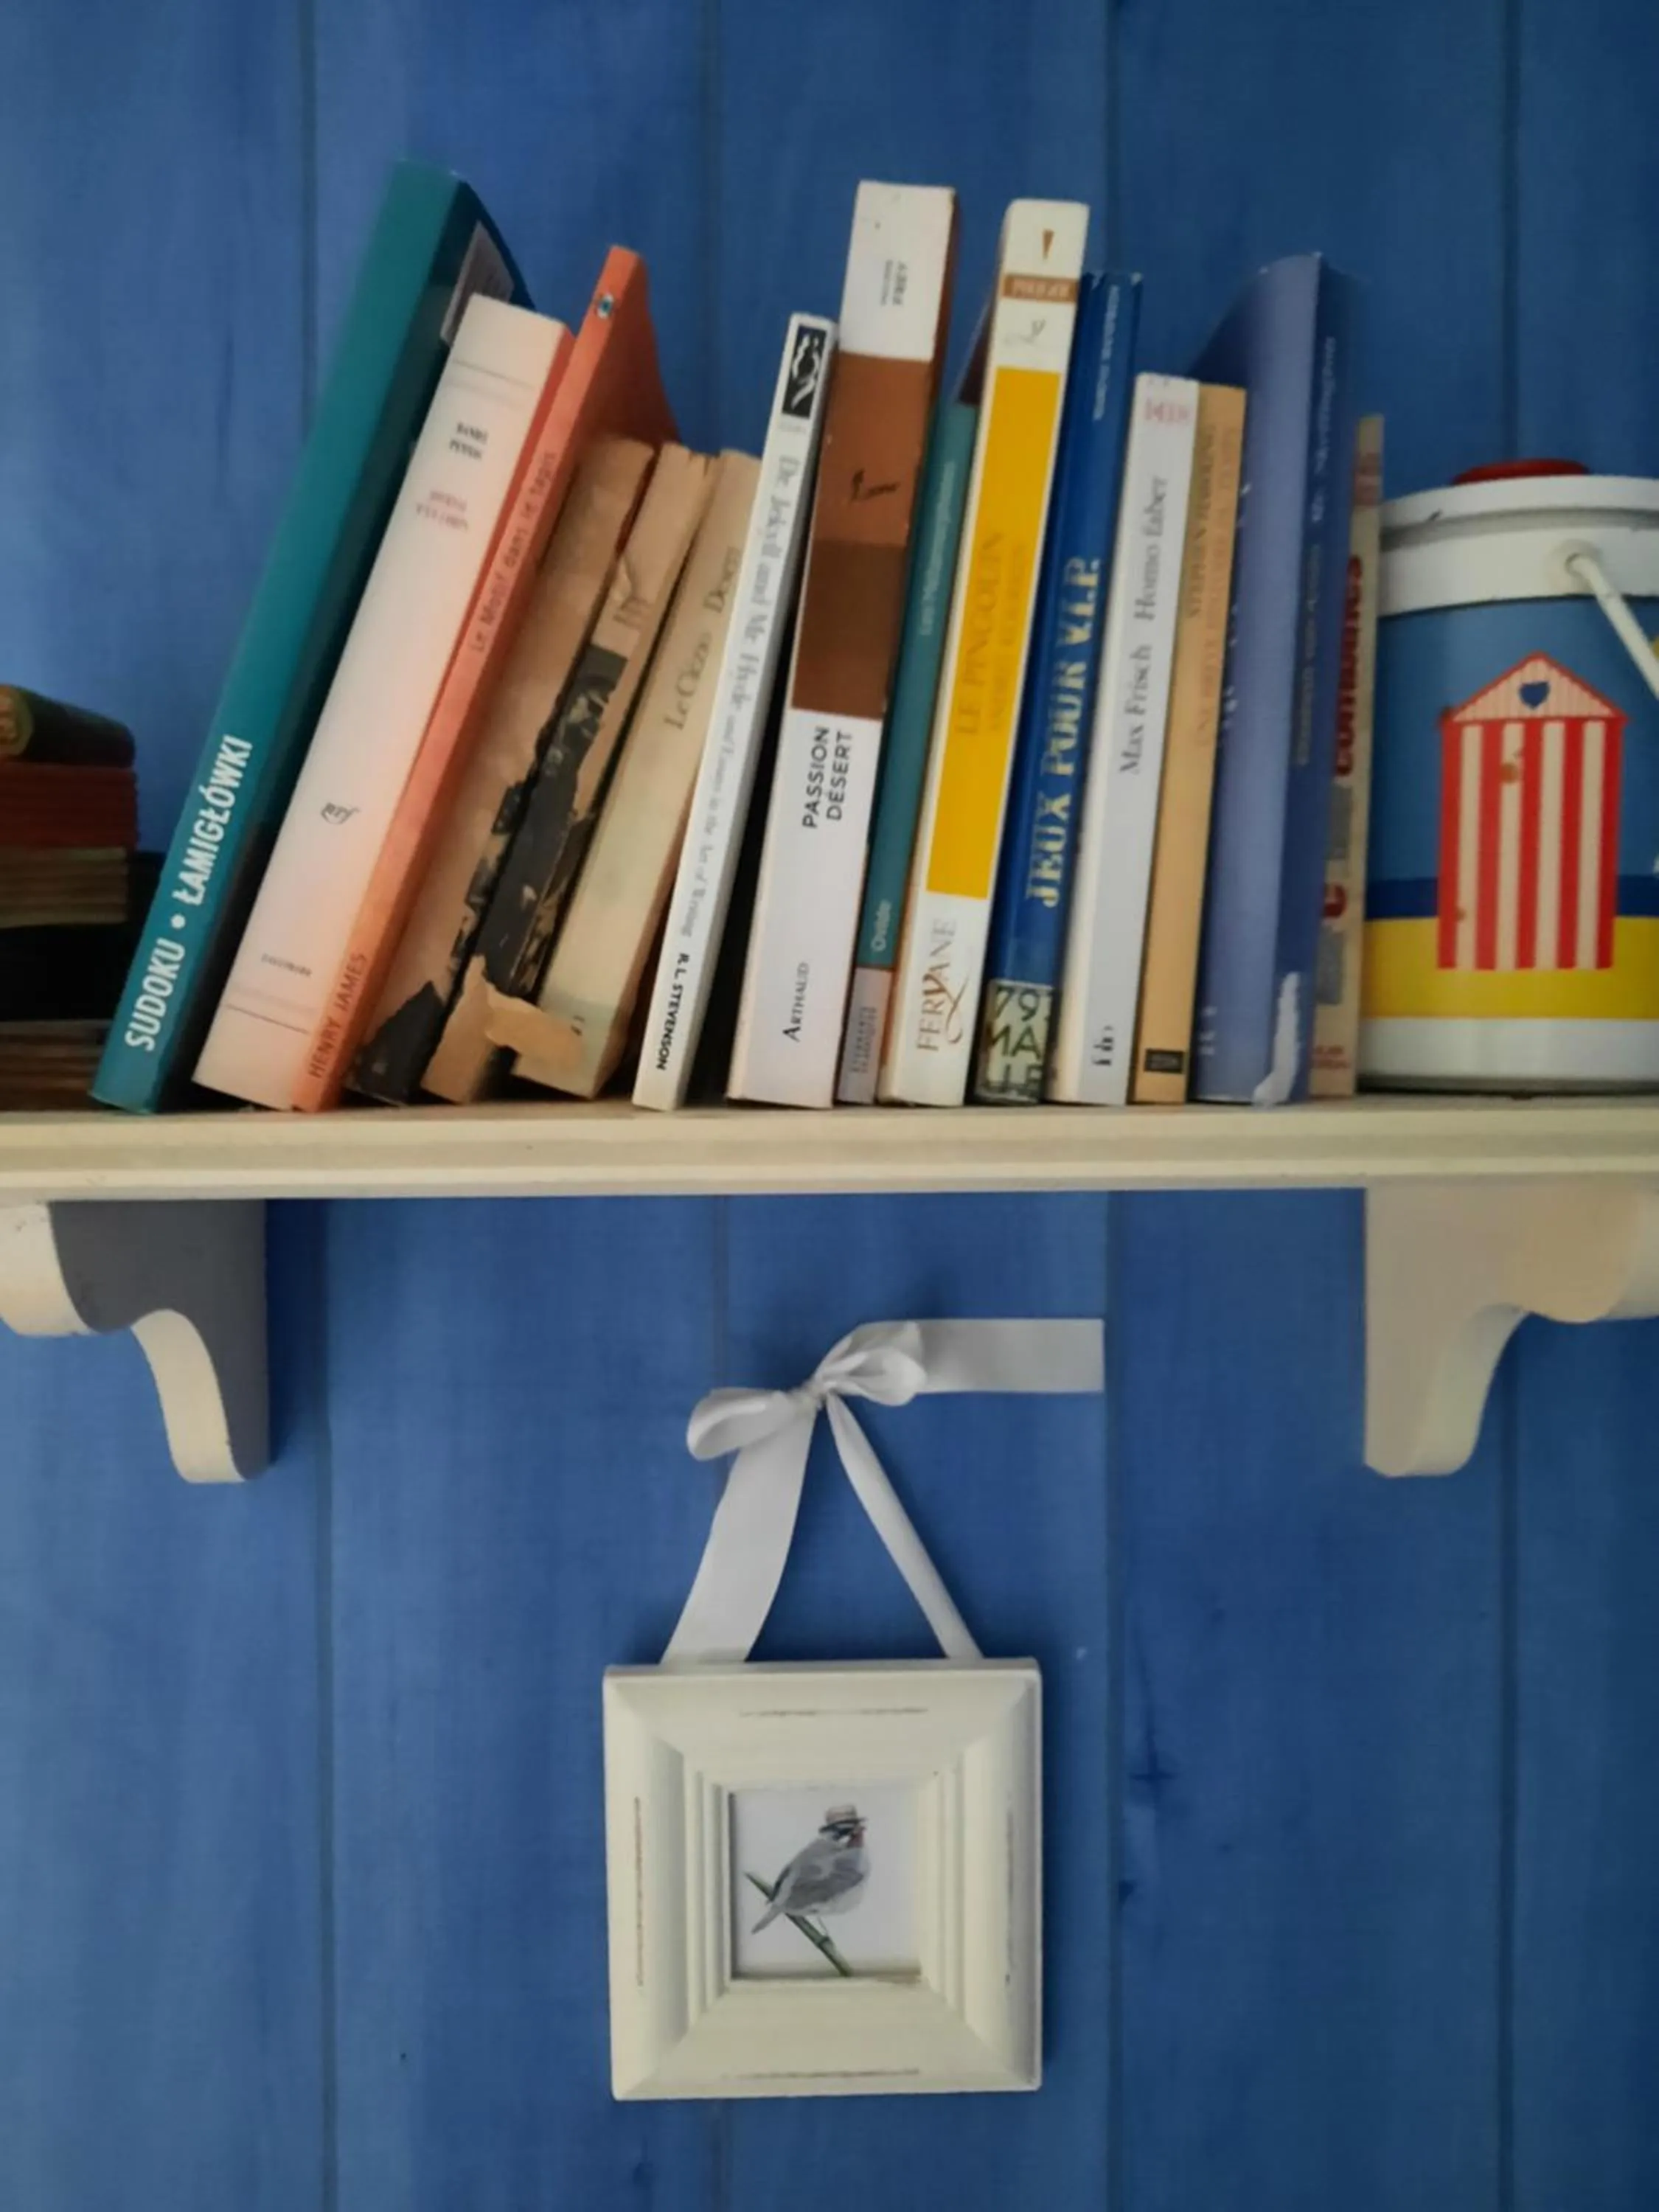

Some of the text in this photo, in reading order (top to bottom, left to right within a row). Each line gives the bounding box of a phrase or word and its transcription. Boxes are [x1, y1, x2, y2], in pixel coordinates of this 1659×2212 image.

[1133, 541, 1161, 620] Homo
[1041, 661, 1086, 777] POUR
[1119, 643, 1152, 775] Max Frisch
[802, 725, 830, 830] PASSION
[125, 734, 253, 1052] SUDOKU ŁAMIGŁÓWKI
[1029, 793, 1071, 908] JEUX
[307, 952, 367, 1079] HENRY JAMES
[656, 983, 684, 1071] STEVENSON
